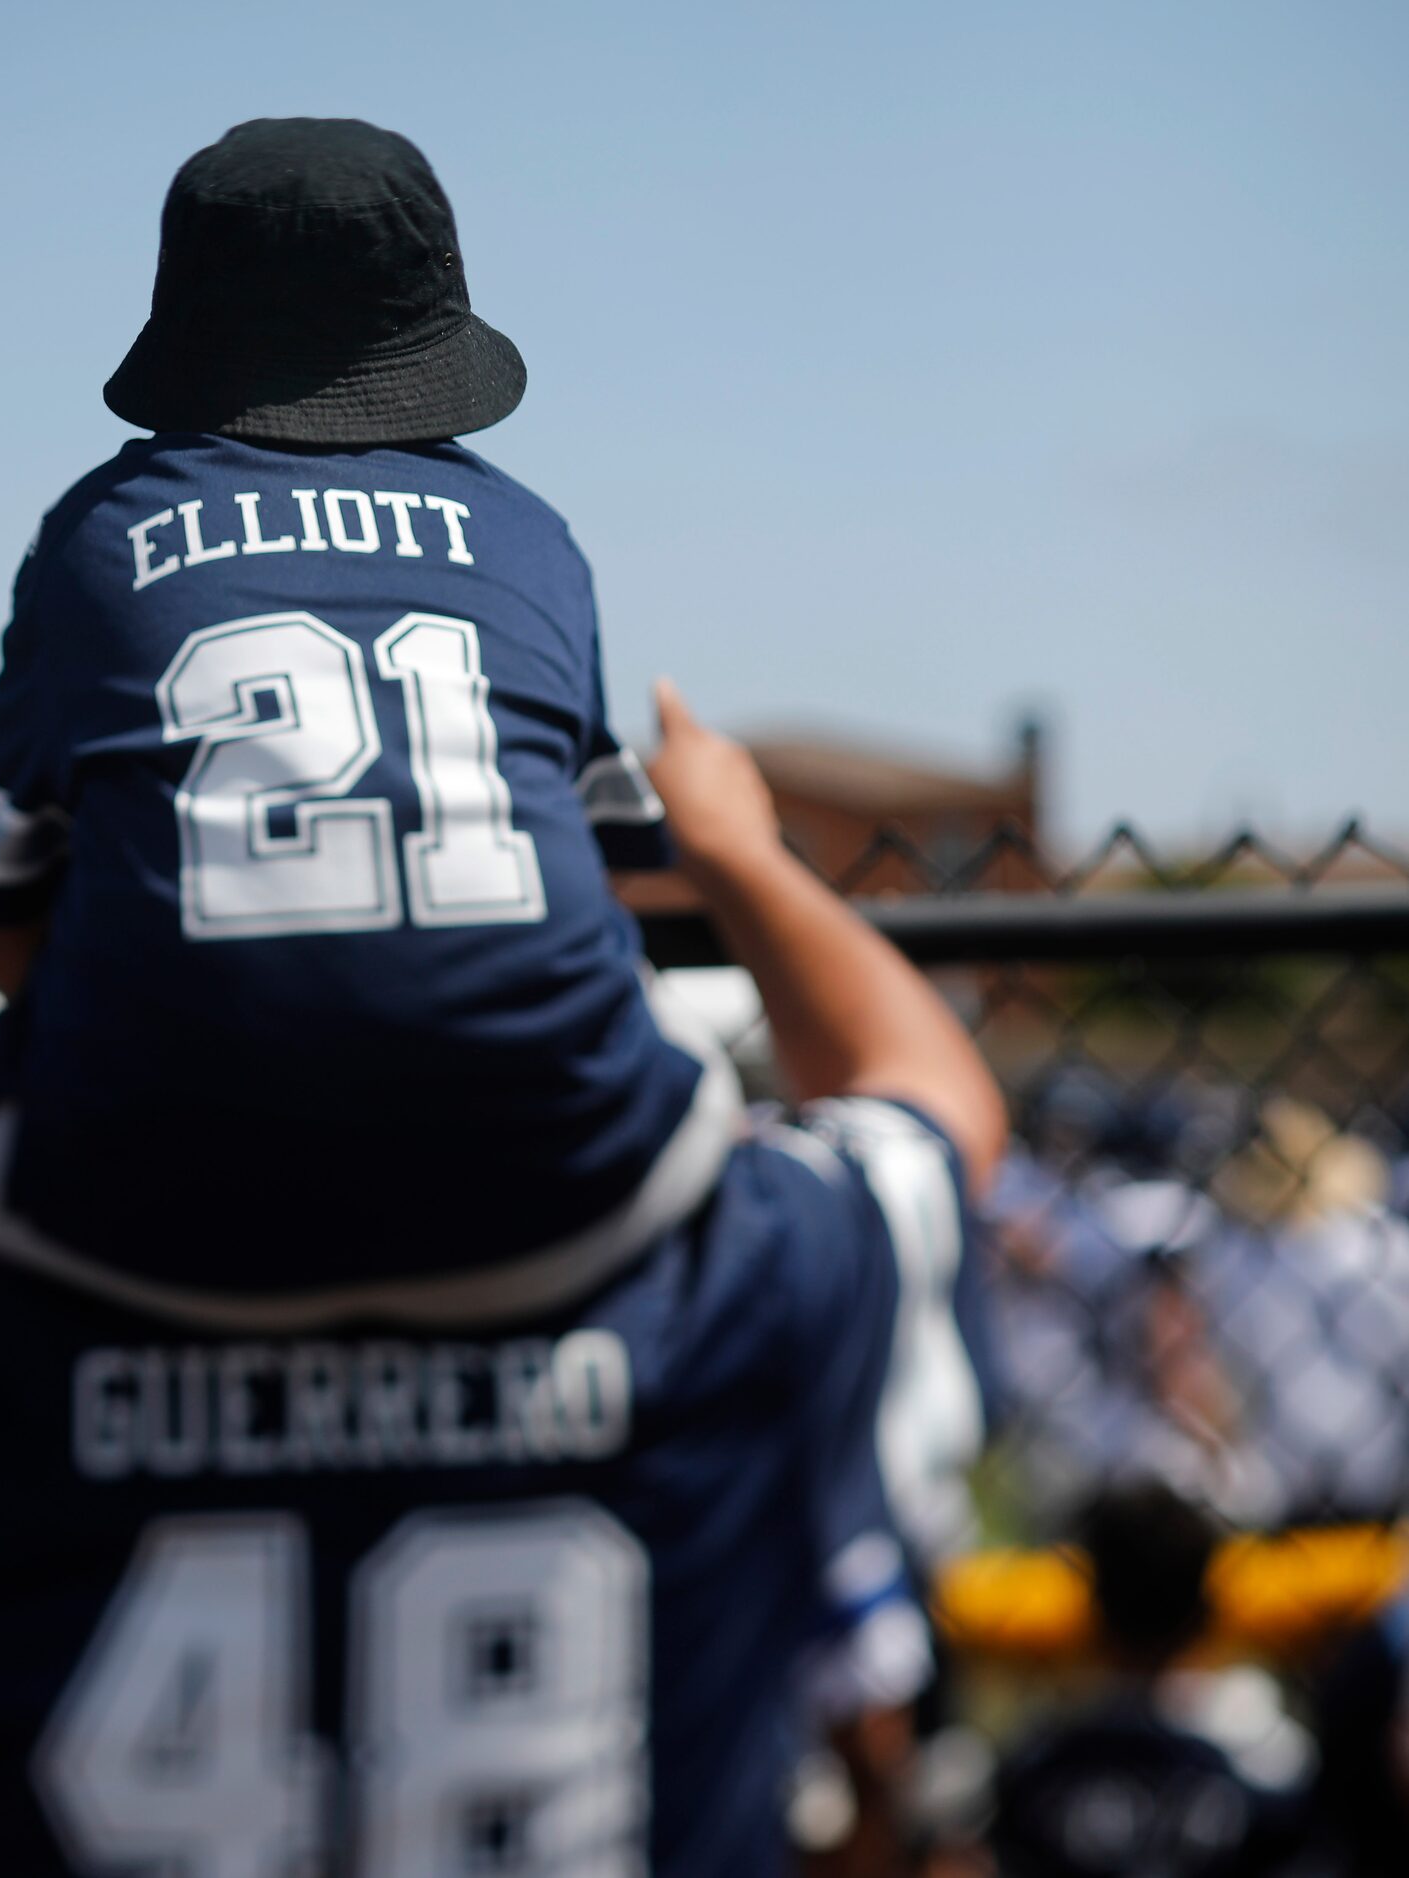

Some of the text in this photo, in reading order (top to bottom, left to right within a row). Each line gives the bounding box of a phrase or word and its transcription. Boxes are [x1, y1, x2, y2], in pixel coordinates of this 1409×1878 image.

[127, 488, 475, 592] ELLIOTT
[155, 610, 548, 941] 21
[72, 1327, 632, 1480] GUERRERO
[28, 1496, 653, 1878] 48
